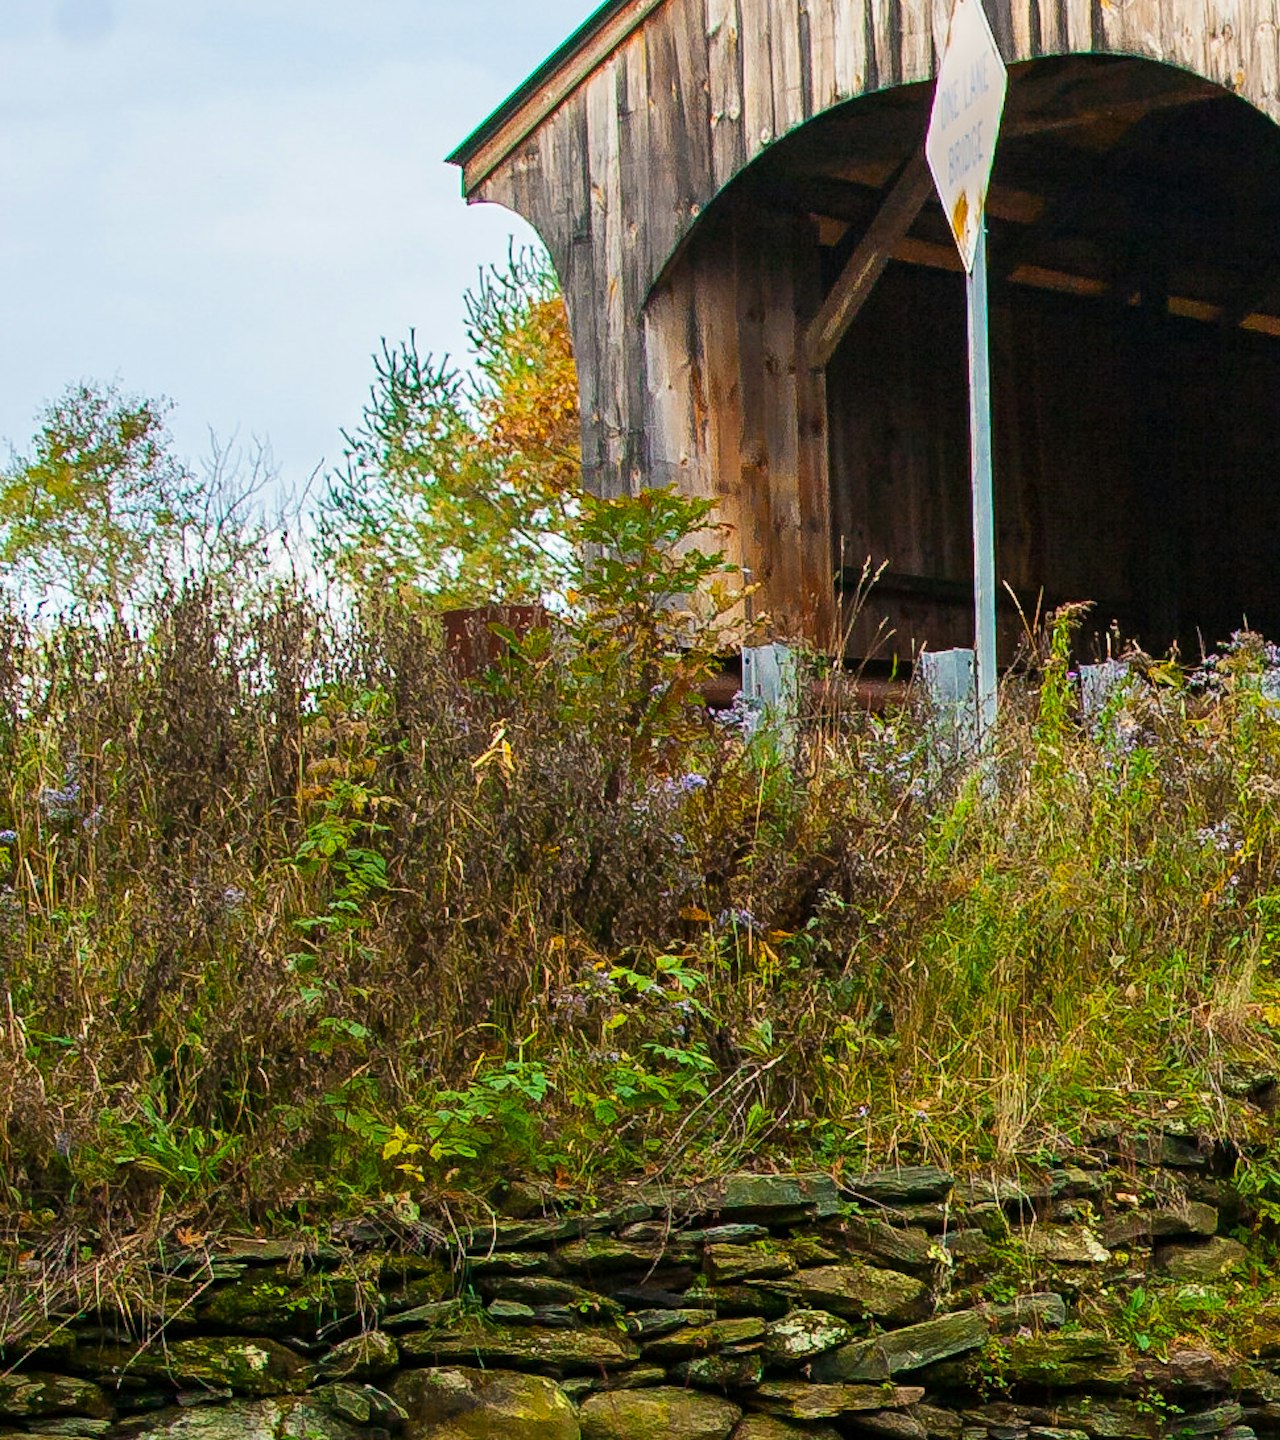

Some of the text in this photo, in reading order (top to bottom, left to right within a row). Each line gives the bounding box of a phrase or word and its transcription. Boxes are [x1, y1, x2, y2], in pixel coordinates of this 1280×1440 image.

[941, 50, 990, 130] ONE LANE
[949, 120, 983, 186] BRIDGE
